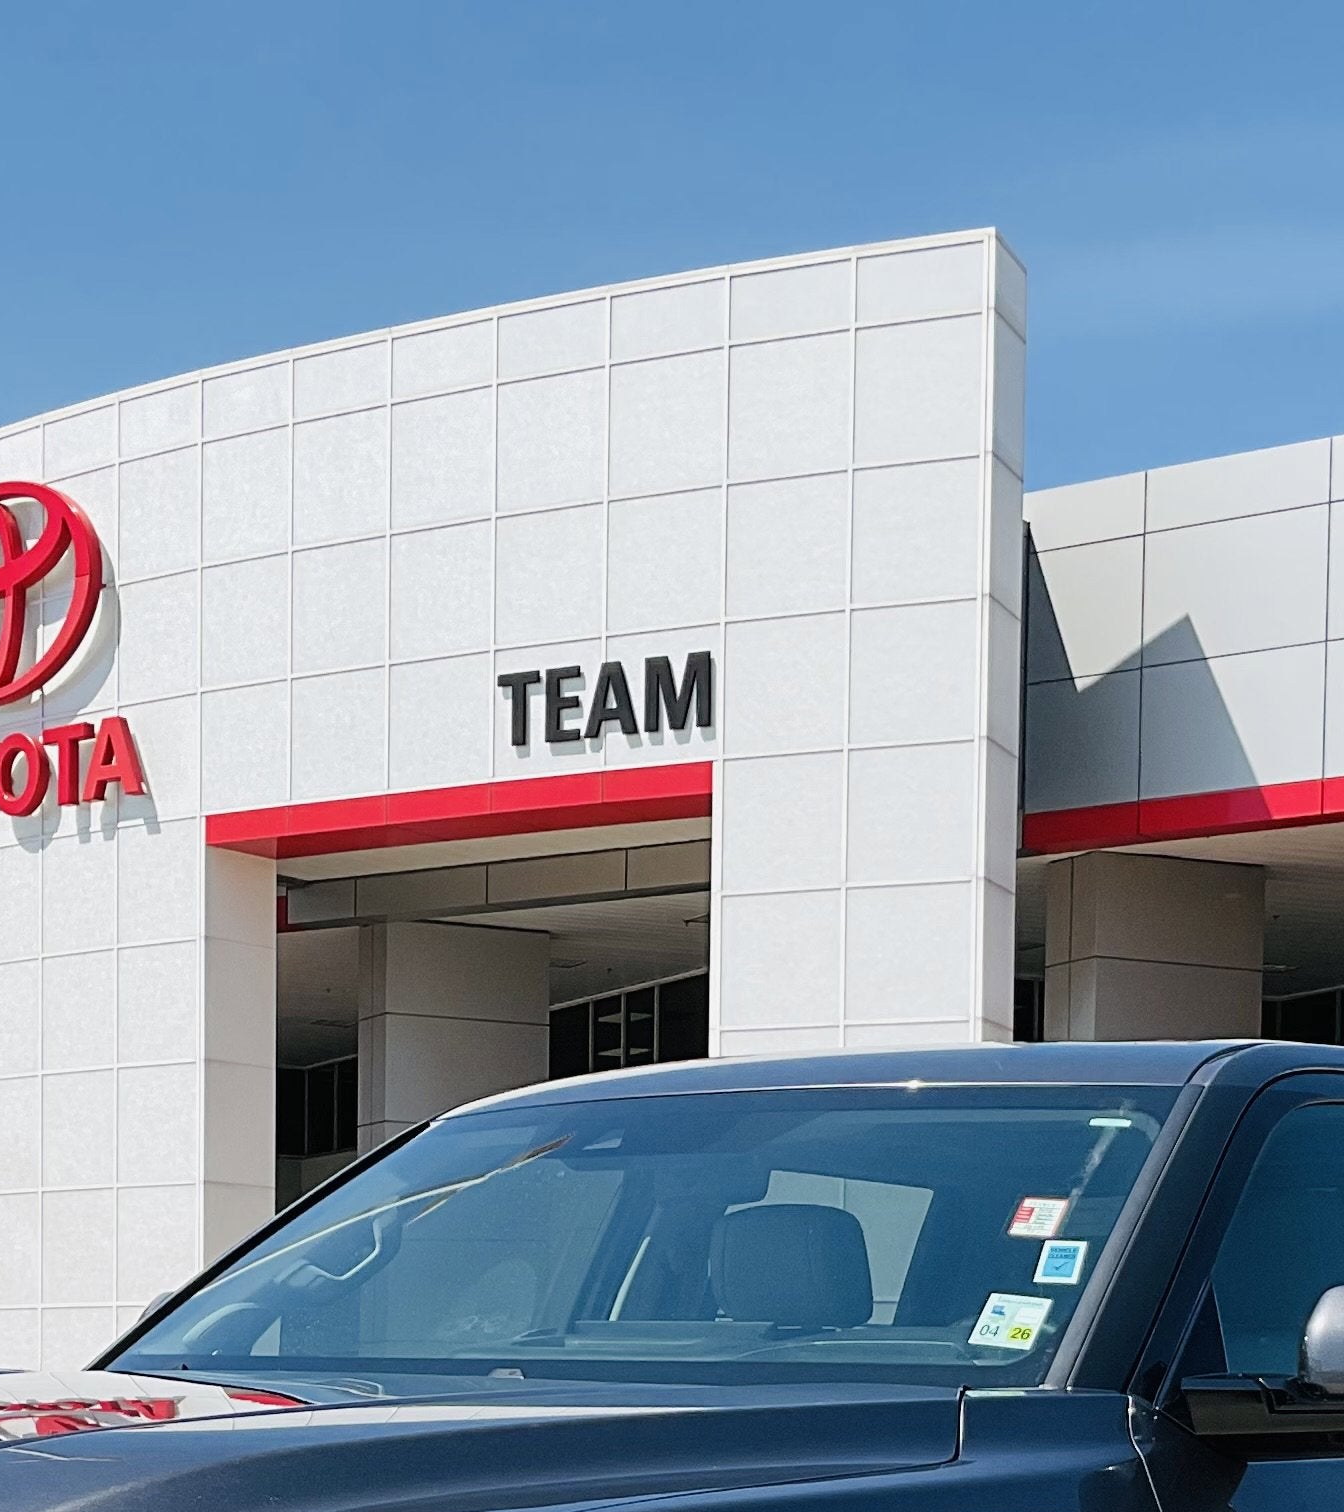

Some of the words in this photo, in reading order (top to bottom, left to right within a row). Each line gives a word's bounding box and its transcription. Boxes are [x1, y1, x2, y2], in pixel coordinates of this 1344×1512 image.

[497, 650, 716, 748] TEAM
[979, 1324, 1000, 1337] 04
[1010, 1327, 1032, 1340] 26
